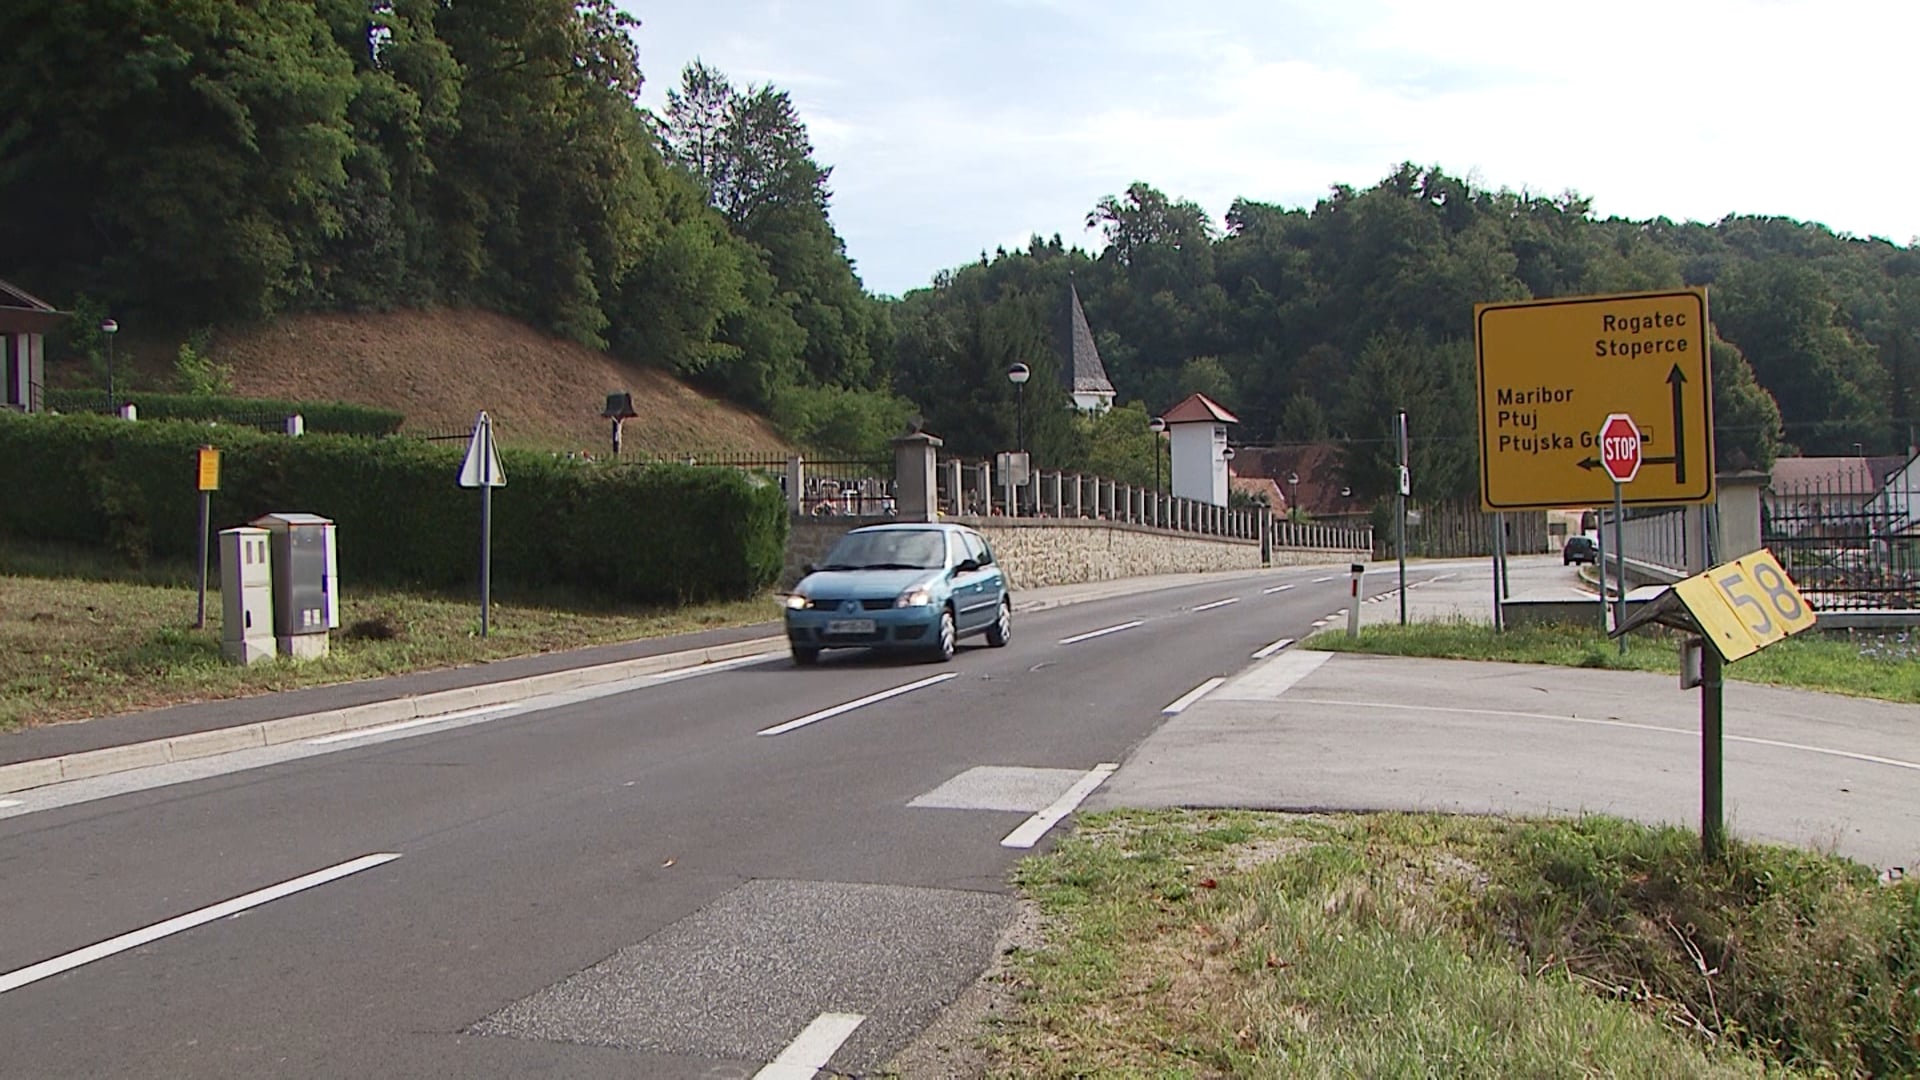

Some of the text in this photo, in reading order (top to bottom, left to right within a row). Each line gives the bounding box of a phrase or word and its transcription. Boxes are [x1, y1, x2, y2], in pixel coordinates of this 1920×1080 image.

[1603, 312, 1686, 334] Rogatec
[1595, 339, 1687, 360] Stoperce
[1497, 386, 1574, 406] Maribor
[1498, 409, 1537, 430] Ptuj
[1499, 433, 1574, 455] Ptujska
[1605, 437, 1636, 461] STOP
[1718, 563, 1802, 635] 58
